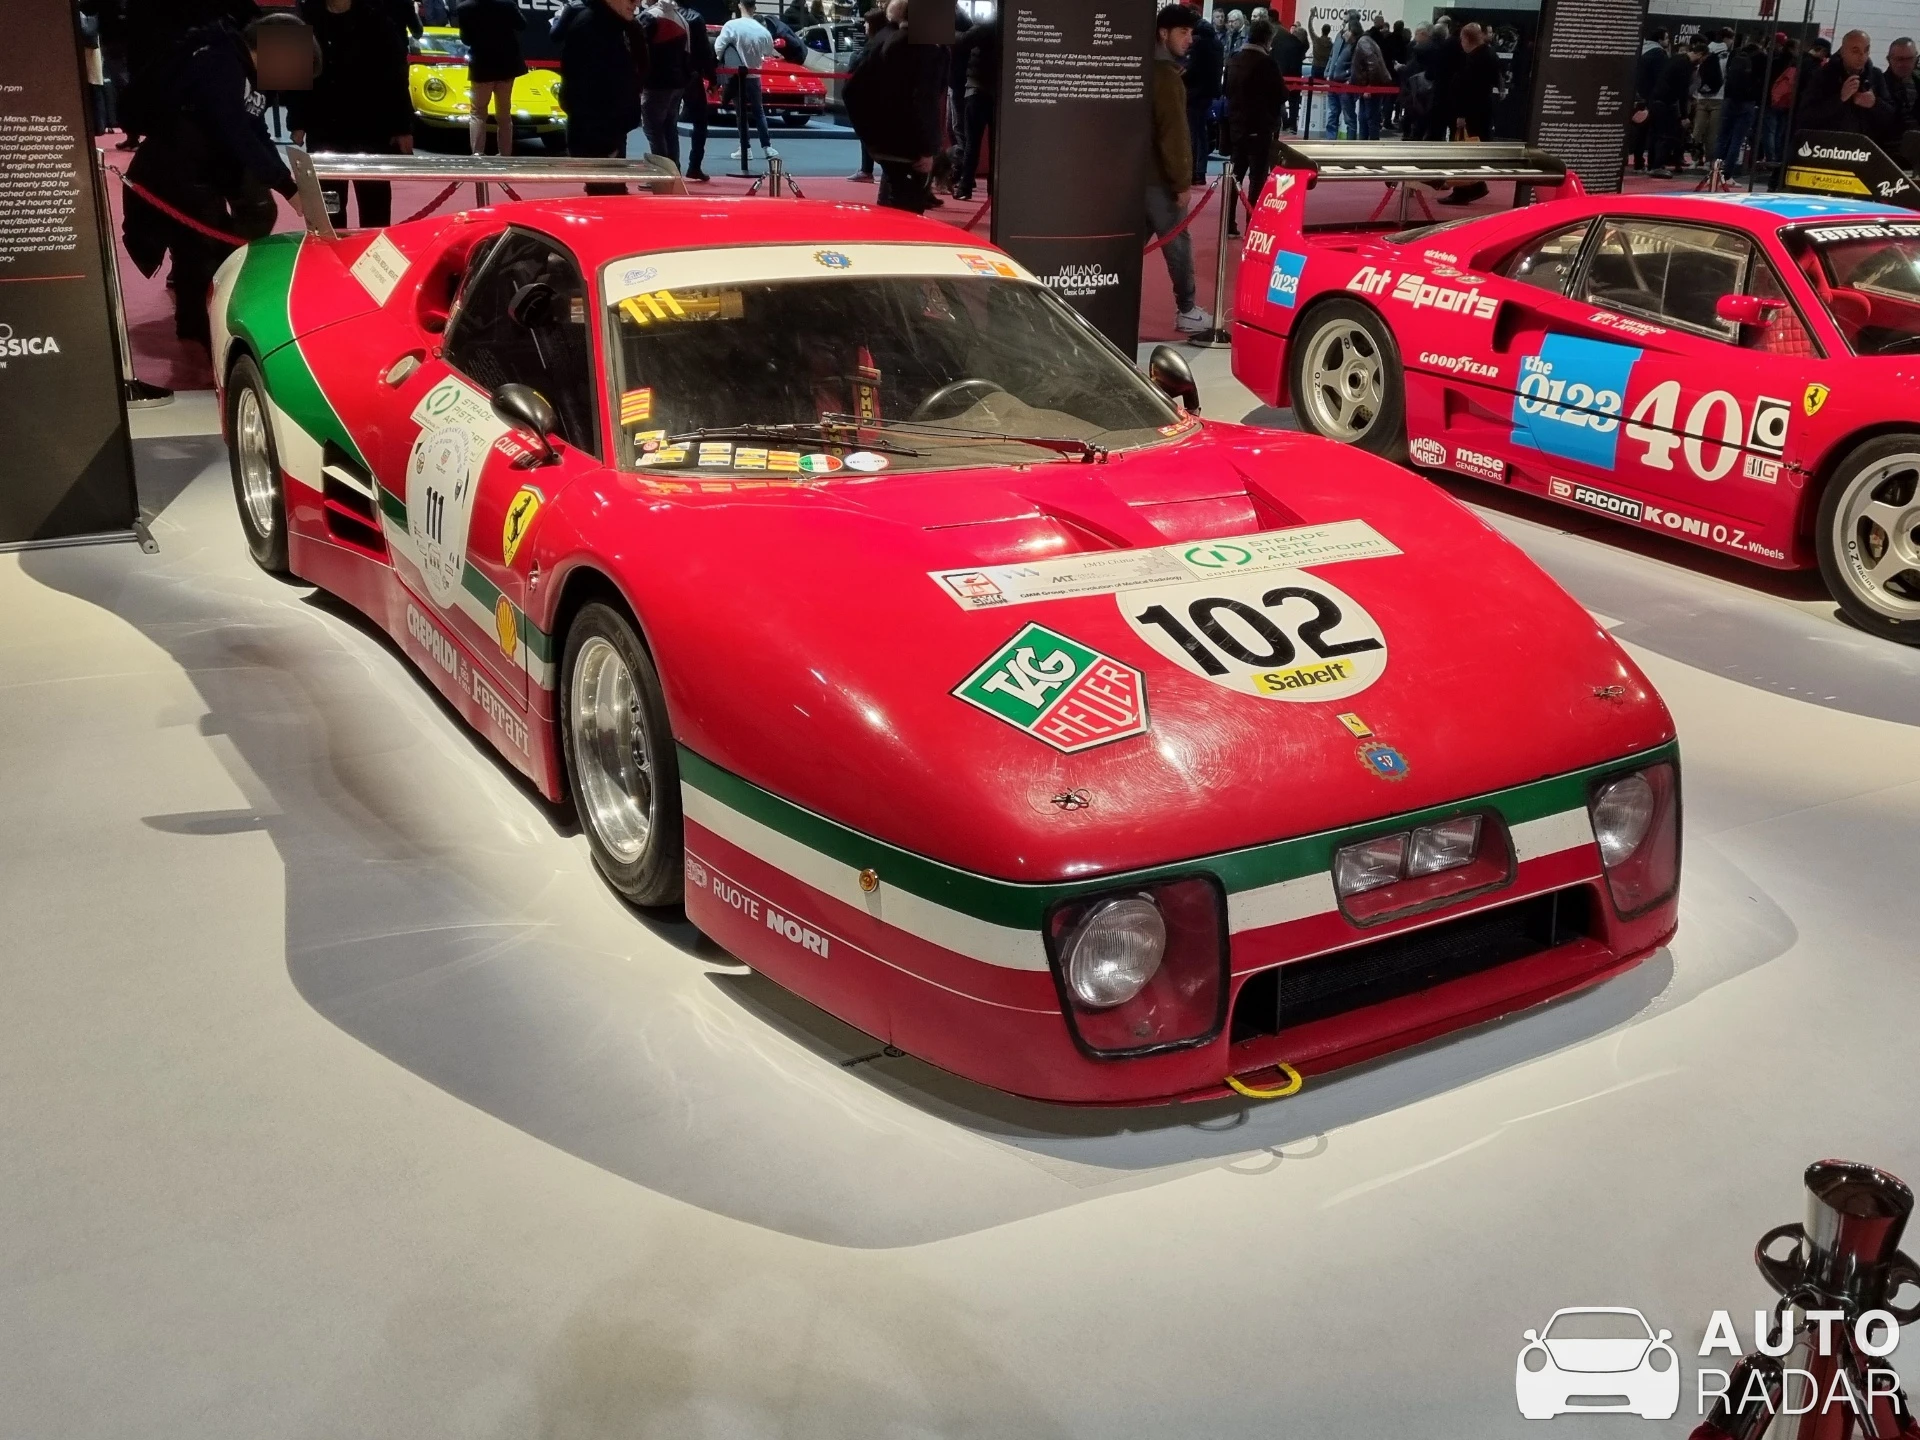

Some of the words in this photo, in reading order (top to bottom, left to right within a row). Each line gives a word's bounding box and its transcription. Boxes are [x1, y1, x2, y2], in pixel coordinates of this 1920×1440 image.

[3, 115, 29, 123] Mans.
[30, 115, 46, 123] The
[46, 115, 63, 123] 512
[18, 134, 42, 143] going
[43, 134, 75, 142] version,
[20, 143, 54, 152] updates
[12, 152, 28, 160] the
[28, 152, 64, 161] gearbox
[1812, 145, 1872, 162] Santander
[6, 162, 36, 171] engine
[36, 161, 55, 169] that
[10, 171, 60, 179] mechanical
[60, 170, 77, 179] fuel
[12, 180, 40, 189] nearly
[41, 180, 58, 188] 500
[58, 180, 70, 189] hp
[38, 189, 52, 197] the
[52, 188, 81, 197] Circuit
[11, 208, 21, 216] in
[21, 208, 36, 216] the
[36, 207, 58, 216] IMSA
[58, 207, 77, 215] GTX
[14, 199, 26, 207] 24
[27, 199, 52, 207] hours
[52, 198, 63, 207] of
[62, 198, 74, 206] Le
[1263, 192, 1288, 213] Group
[28, 226, 51, 234] IMSA
[51, 225, 74, 234] class
[47, 234, 67, 243] Only
[66, 233, 79, 242] 27
[9, 245, 37, 253] rarest
[37, 244, 55, 252] and
[55, 243, 77, 251] most
[1245, 230, 1276, 255] FPM
[1060, 263, 1102, 277] MILANO
[1273, 265, 1283, 273] the
[1063, 287, 1078, 296] Classic
[1085, 287, 1097, 295] Show
[1269, 271, 1299, 294] 0123
[1345, 265, 1392, 295] Art
[1391, 272, 1498, 320] Sports
[618, 290, 685, 324] 111
[1524, 355, 1553, 375] the
[461, 398, 495, 422] STRADE
[1518, 373, 1622, 434] 0123
[452, 406, 476, 424] PISTE
[1625, 380, 1743, 482] 40
[494, 436, 521, 457] CLUB
[1456, 447, 1504, 472] mase
[1455, 460, 1502, 481] GENERATORS
[1575, 487, 1640, 518] FACOM
[426, 485, 445, 546] 111
[1644, 505, 1710, 539] KONI
[1247, 530, 1330, 547] STRADE
[1256, 540, 1317, 555] PISTE
[1712, 524, 1748, 551] O.Z.
[1748, 540, 1785, 561] Wheels
[1267, 540, 1381, 561] AEROPORTI
[1107, 558, 1135, 567] China
[1205, 564, 1269, 578] COMPAGNIA
[1271, 557, 1320, 569] ITALIANA
[1321, 548, 1390, 563] COSTRUZIONI
[1020, 590, 1042, 599] GMM
[1068, 586, 1081, 594] the
[1081, 583, 1114, 592] evolution
[1122, 578, 1148, 588] Medical
[1148, 575, 1183, 586] Radiology
[1856, 564, 1876, 591] Racing
[406, 603, 458, 681] CREPALDI
[1134, 586, 1385, 677] 102
[979, 646, 1077, 710] TAG
[1262, 662, 1347, 692] Sabelt
[471, 667, 530, 759] Ferrari
[1042, 664, 1132, 742] HEUER
[713, 876, 760, 922] RUOTE
[766, 908, 829, 960] NORI
